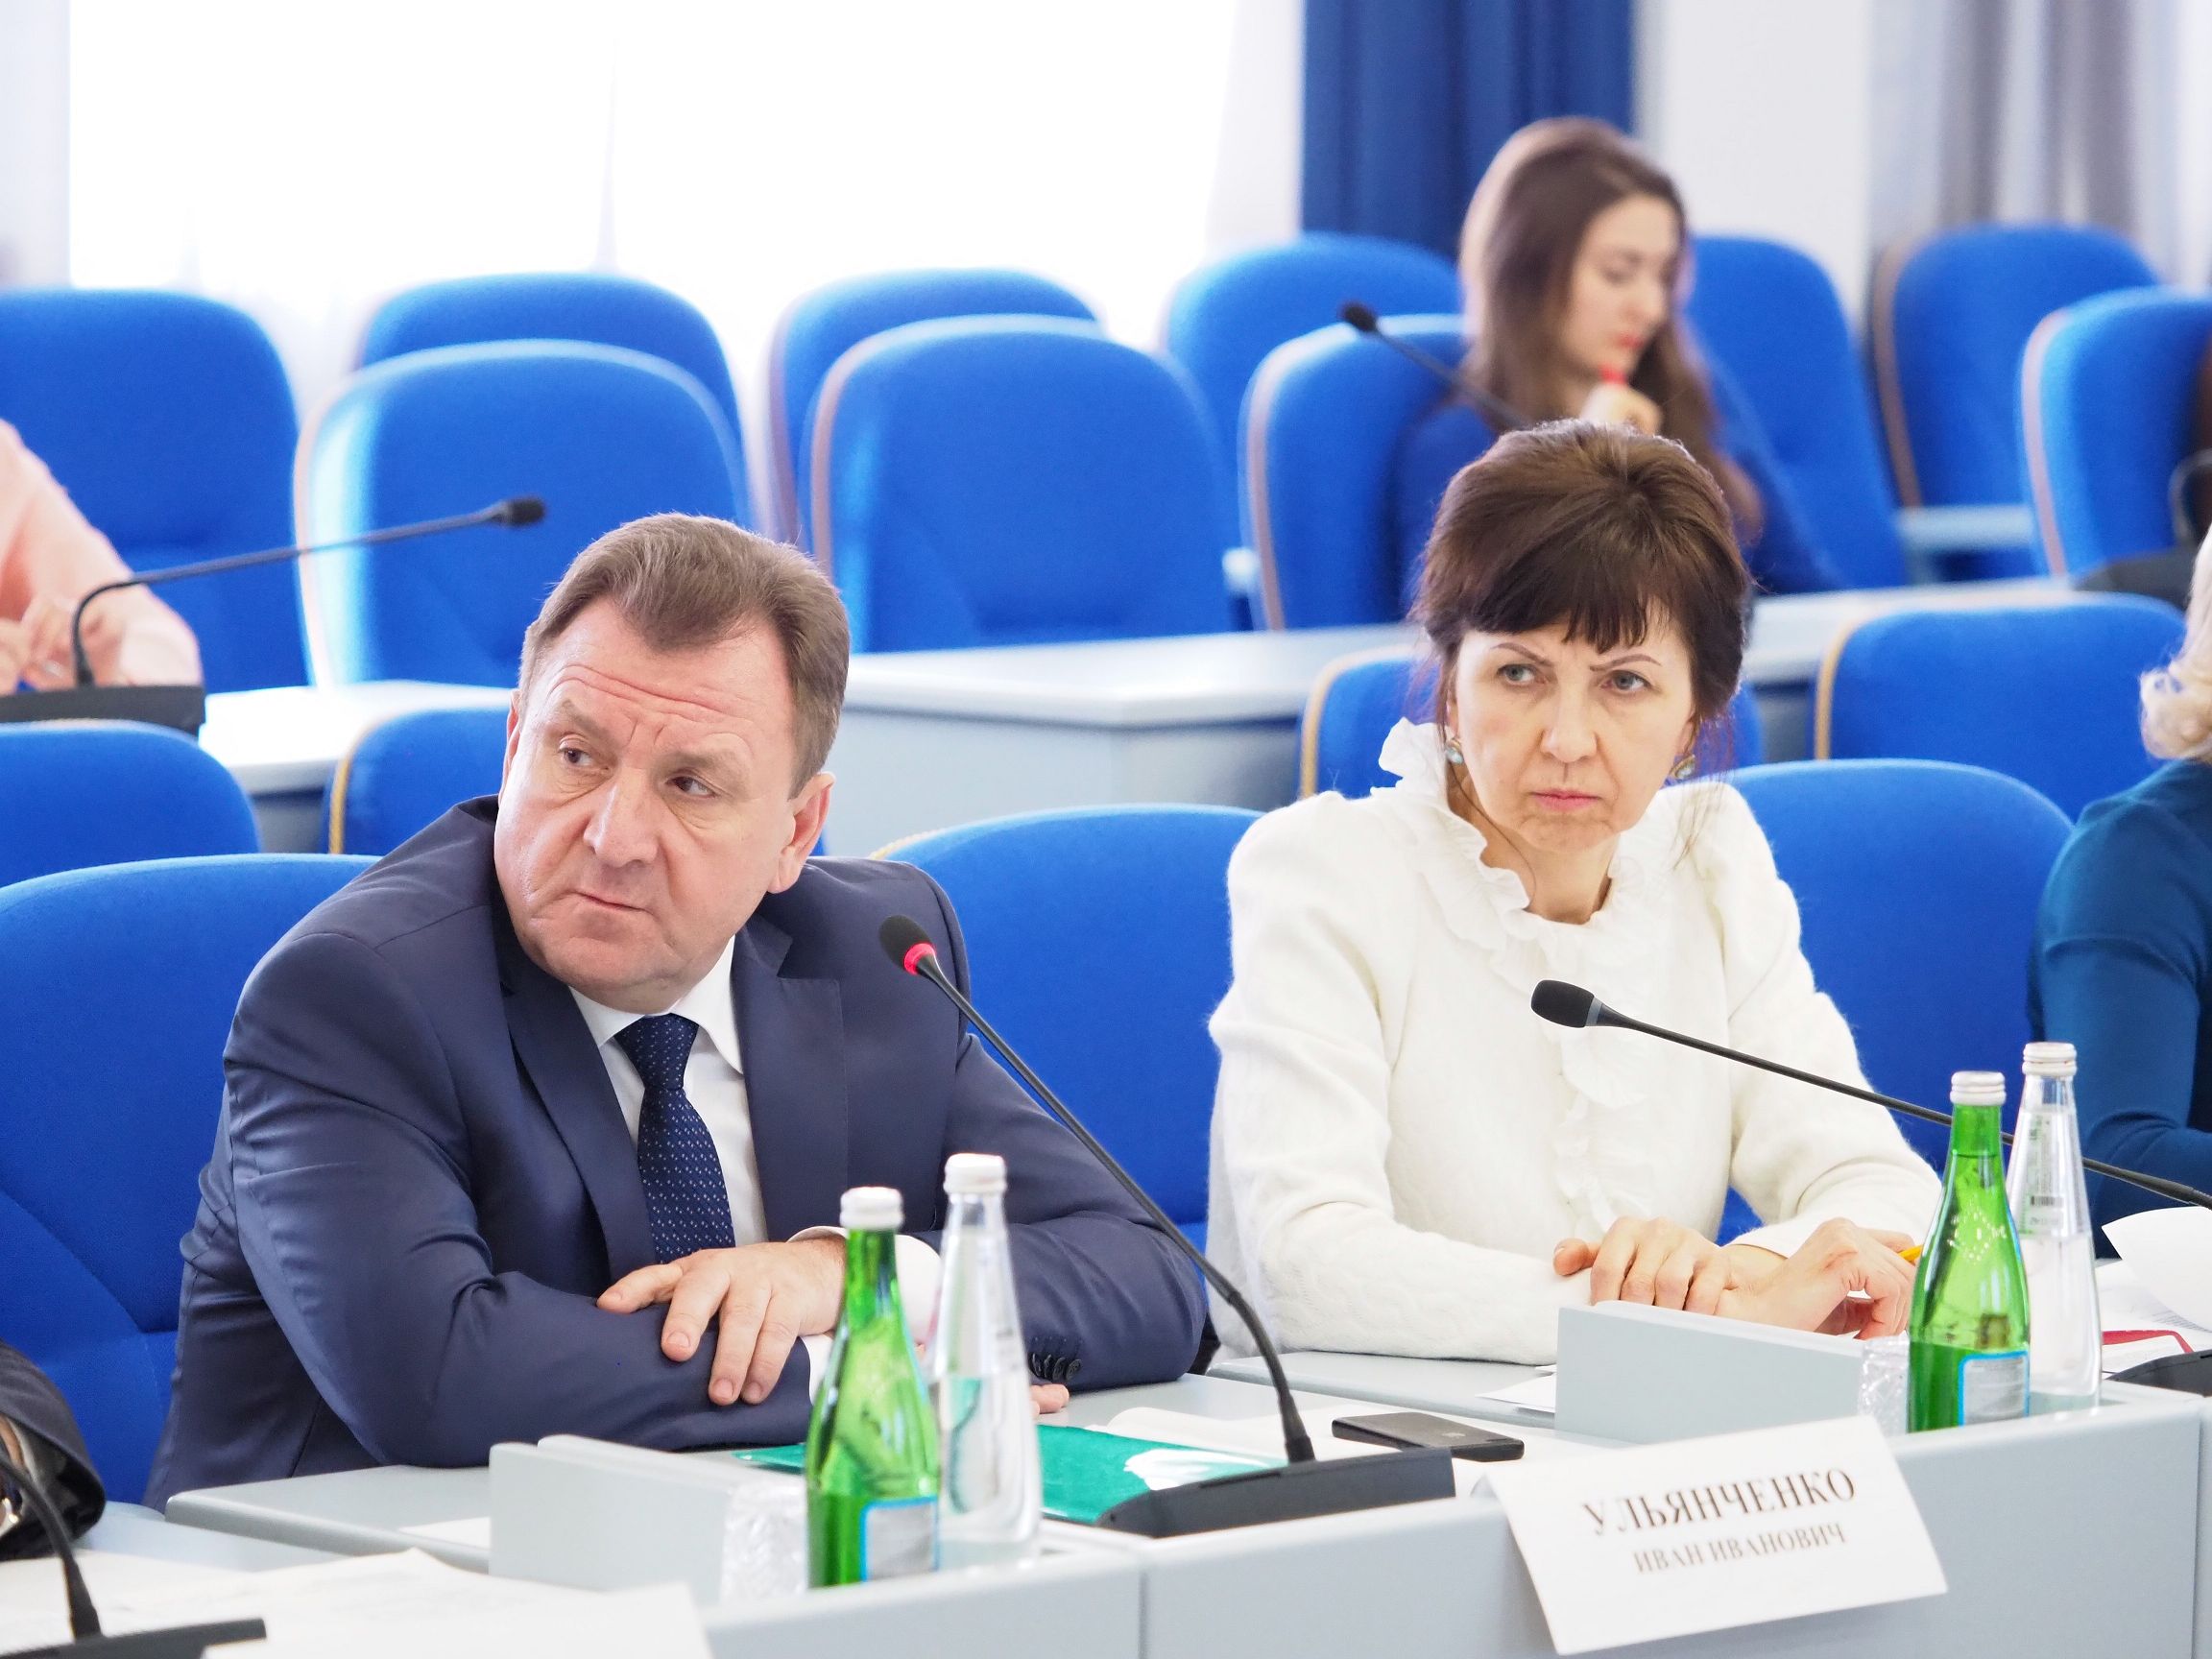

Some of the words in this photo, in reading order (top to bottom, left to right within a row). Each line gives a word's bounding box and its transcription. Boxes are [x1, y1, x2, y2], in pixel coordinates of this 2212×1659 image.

[1582, 1469, 1856, 1534] УЛЬЯНЧЕНКО
[1634, 1544, 1703, 1573] ИВАН
[1710, 1524, 1846, 1563] ИВАНОВИЧ
